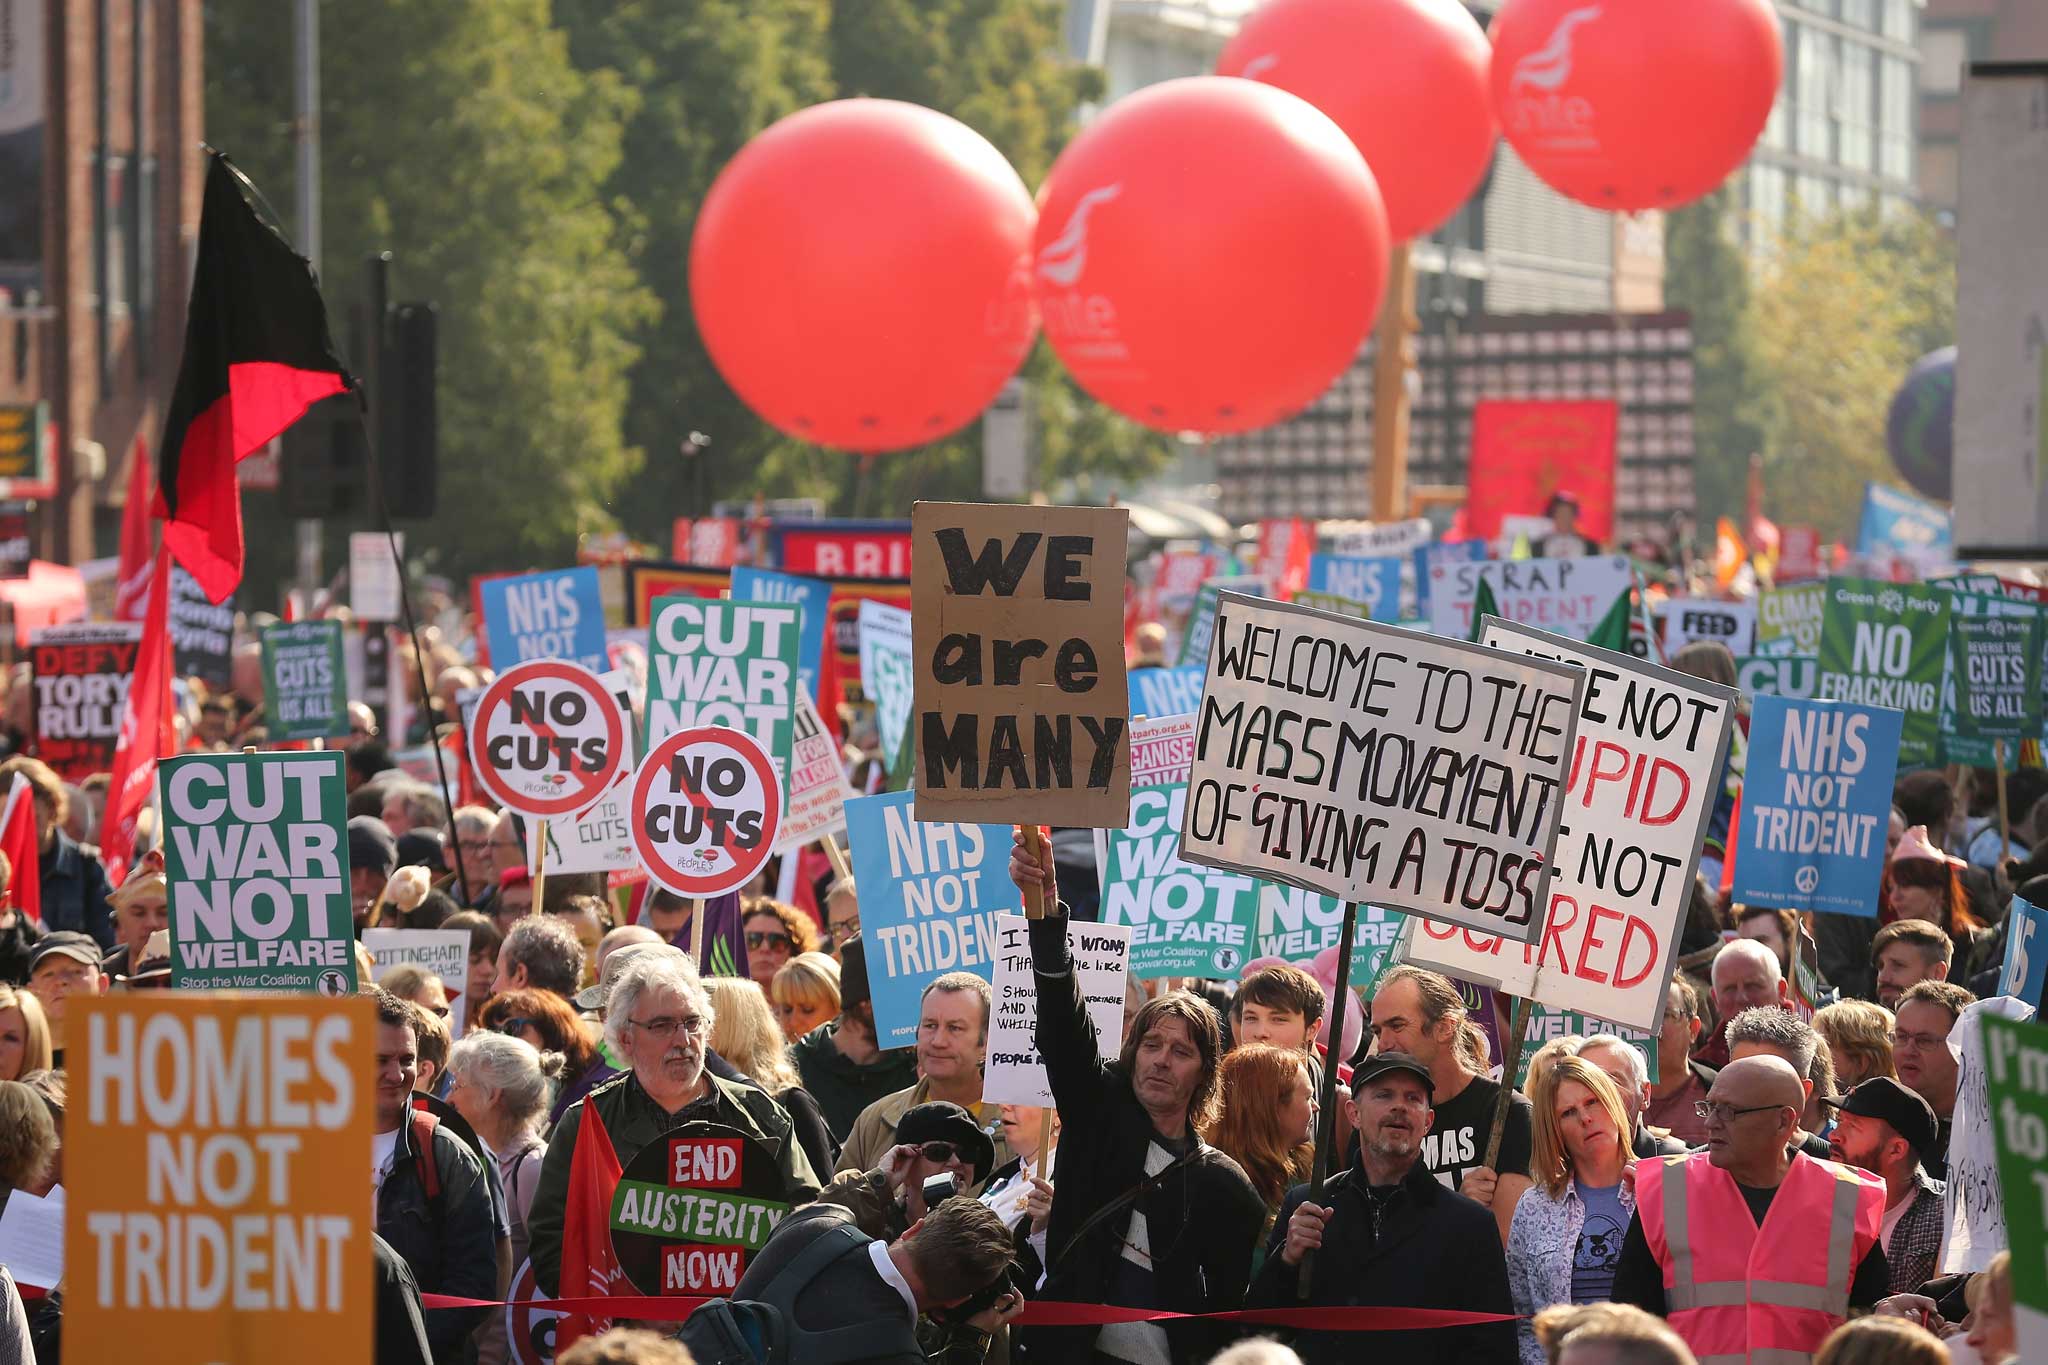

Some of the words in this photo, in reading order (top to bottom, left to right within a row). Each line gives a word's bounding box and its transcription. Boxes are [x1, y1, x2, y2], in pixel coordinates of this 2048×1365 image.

[815, 541, 911, 577] BRI
[935, 528, 1094, 600] WE
[1326, 560, 1383, 604] NHS
[505, 577, 580, 635] NHS
[1452, 595, 1595, 627] TIDENT
[1682, 611, 1738, 637] FEED
[1906, 595, 1941, 616] Party
[517, 630, 577, 661] NOT
[656, 603, 795, 659] CUT
[1853, 621, 1912, 678] NO
[36, 644, 135, 675] DEFY
[275, 657, 333, 688] CUTS
[654, 654, 790, 705] WAR
[932, 632, 1098, 693] are
[1967, 655, 2025, 684] CUTS
[35, 671, 134, 706] TORY
[278, 699, 300, 721] US
[304, 697, 335, 719] ALL
[510, 690, 587, 726] NO
[1140, 670, 1204, 718] NHS
[1217, 615, 1407, 717] WELCOME
[1415, 661, 1473, 734] TO
[1482, 676, 1572, 764] THE
[1820, 670, 1935, 714] FRACKING
[1970, 694, 1991, 718] US
[1996, 695, 2027, 718] ALL
[1131, 722, 1192, 739] tparty.org.uk
[1618, 680, 1719, 751] NOT
[486, 734, 607, 772] CUTS
[922, 711, 1125, 794] MANY
[1780, 708, 1870, 775] NHS
[169, 760, 336, 825] CUT
[669, 755, 746, 797] NO
[1197, 696, 1333, 786] MASS
[1329, 721, 1560, 846] MOVEMENT
[1784, 774, 1855, 808] NOT
[578, 818, 628, 843] CUTS
[600, 802, 618, 818] TO
[645, 803, 763, 850] CUTS
[171, 823, 341, 880] WAR
[883, 802, 985, 879] NHS
[1191, 779, 1247, 845] OF
[1389, 826, 1427, 895] A
[1754, 806, 1877, 859] TRIDENT
[1578, 833, 1682, 907] NOT
[174, 877, 342, 941] NOT
[902, 871, 981, 919] NOT
[1104, 873, 1253, 925] NOT
[178, 940, 348, 969] WELFARE
[427, 961, 462, 977] SAYS
[1142, 948, 1160, 959] War
[1162, 946, 1208, 958] Coalition
[180, 977, 209, 989] Stop
[212, 976, 231, 987] the
[233, 976, 257, 987] War
[260, 974, 311, 986] Coalition
[997, 1017, 1037, 1031] WHILE
[999, 1001, 1026, 1015] AND
[88, 1012, 356, 1130] HOMES
[992, 1052, 1033, 1067] PEOPLE
[1420, 1126, 1475, 1170] MAS
[2001, 1097, 2048, 1163] to
[147, 1132, 303, 1209] NOT
[674, 1144, 737, 1182] END
[618, 1188, 784, 1244] AUSTERITY
[87, 1211, 351, 1313] TRIDENT
[666, 1252, 738, 1290] NOW
